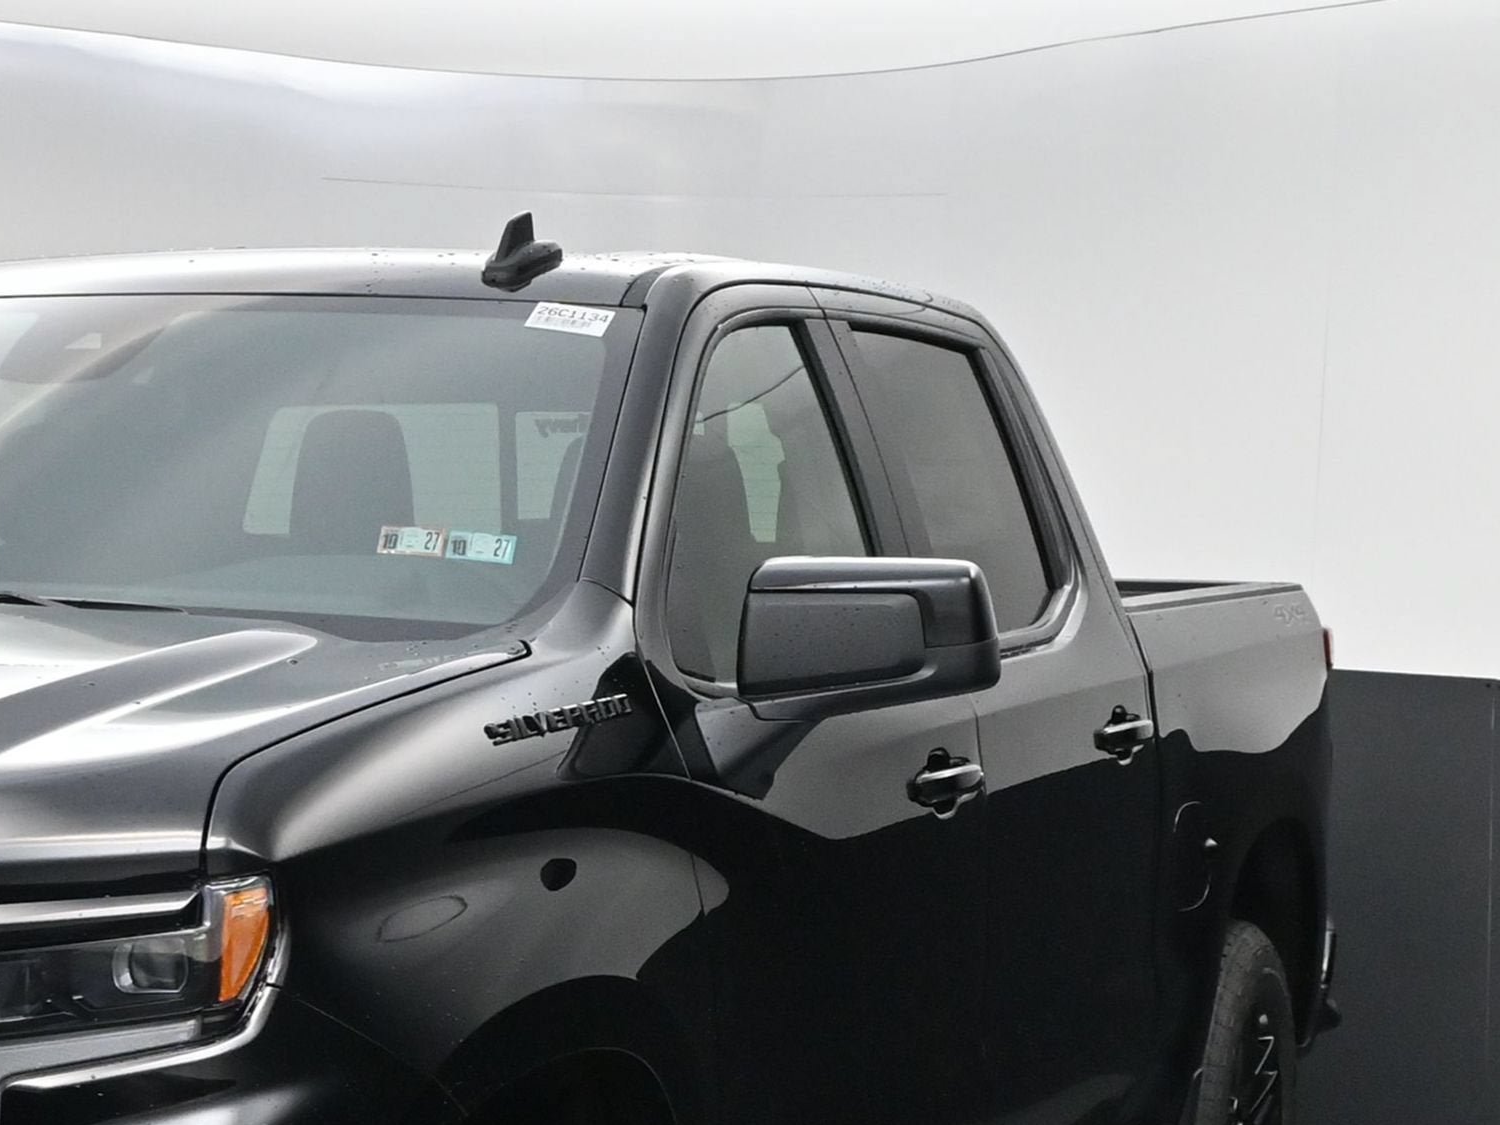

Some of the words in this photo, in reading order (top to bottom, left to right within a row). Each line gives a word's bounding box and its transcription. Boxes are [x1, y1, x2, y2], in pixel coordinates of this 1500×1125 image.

[538, 306, 609, 323] 26C1134
[383, 533, 399, 549] 10
[424, 532, 440, 551] 27
[451, 539, 467, 556] 10
[493, 538, 510, 557] 27
[484, 693, 633, 746] SILVERADO
